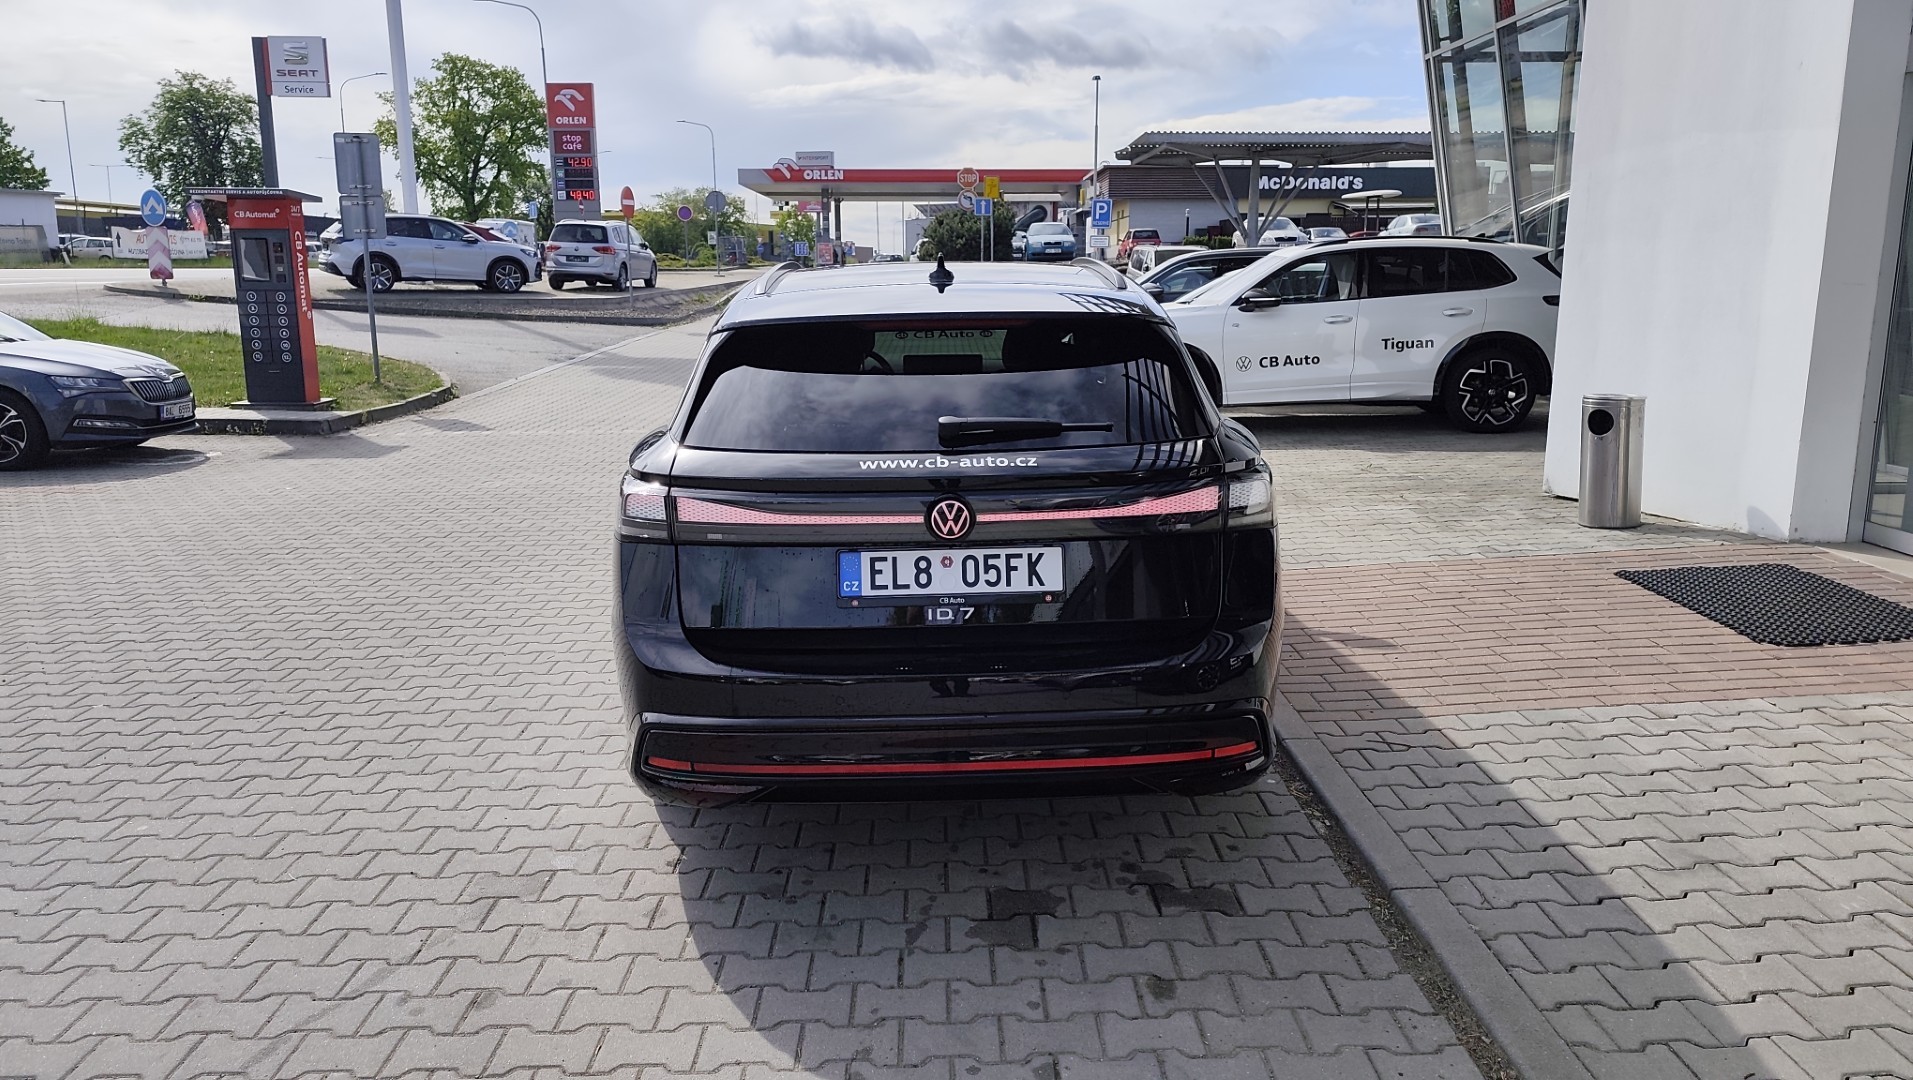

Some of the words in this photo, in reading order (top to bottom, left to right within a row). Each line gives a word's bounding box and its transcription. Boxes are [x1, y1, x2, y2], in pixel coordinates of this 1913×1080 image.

[276, 69, 318, 77] SEAT
[284, 85, 314, 93] Service
[555, 116, 587, 124] ORLEN
[562, 134, 581, 143] stop
[562, 142, 582, 150] cafe
[803, 170, 844, 180] ORLEN
[960, 173, 976, 182] STOP
[1258, 175, 1363, 190] McDonald's
[245, 210, 277, 218] Automat
[1096, 202, 1108, 220] P
[294, 230, 303, 250] CB
[296, 252, 308, 312] Automat
[914, 330, 935, 339] CB
[938, 330, 975, 338] Auto
[1381, 337, 1434, 352] Tiguan
[1258, 356, 1279, 368] CB
[1282, 354, 1320, 367] Auto
[859, 456, 1038, 469] www.cb-auto.cz
[869, 555, 932, 591] EL8
[961, 553, 1046, 588] 05FK
[843, 581, 859, 591] CZ
